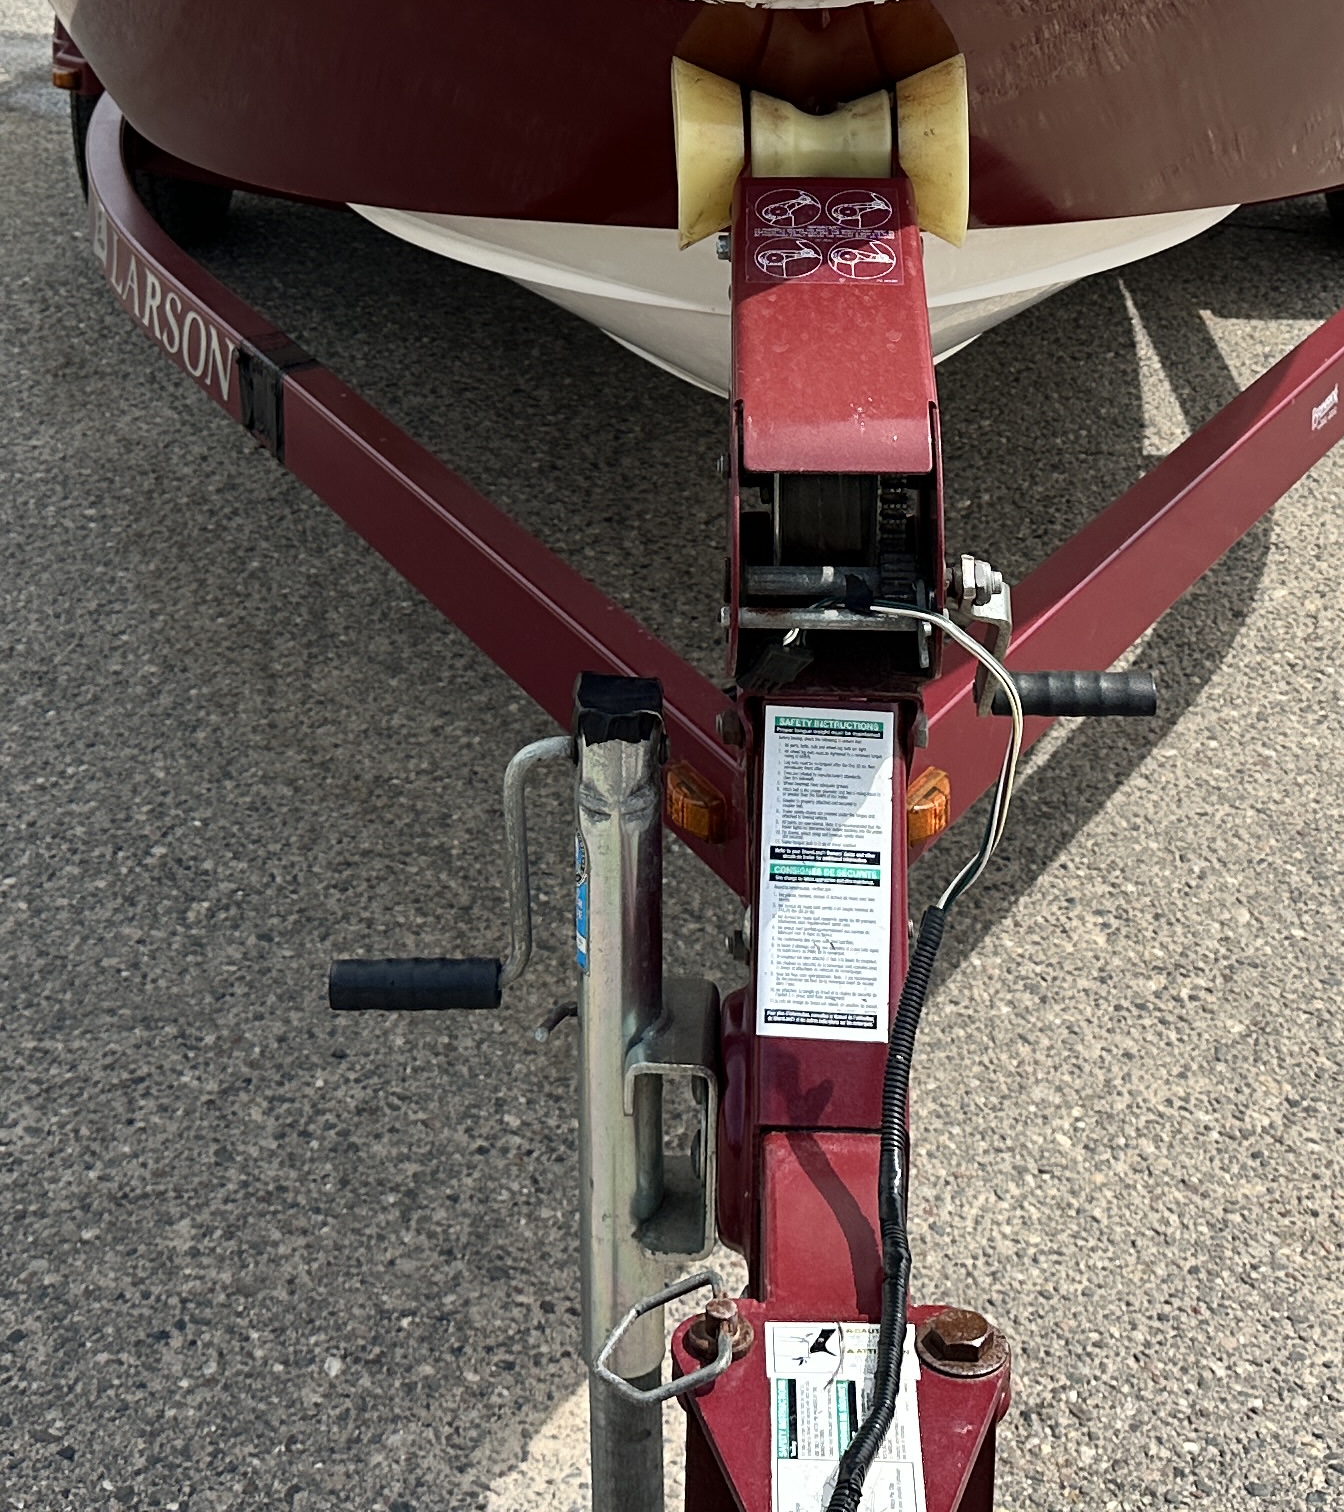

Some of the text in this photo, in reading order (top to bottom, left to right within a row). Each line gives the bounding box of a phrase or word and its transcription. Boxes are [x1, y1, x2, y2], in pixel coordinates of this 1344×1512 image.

[110, 229, 236, 402] LARSON
[779, 717, 879, 732] SAFETY INSTRUCTIONS
